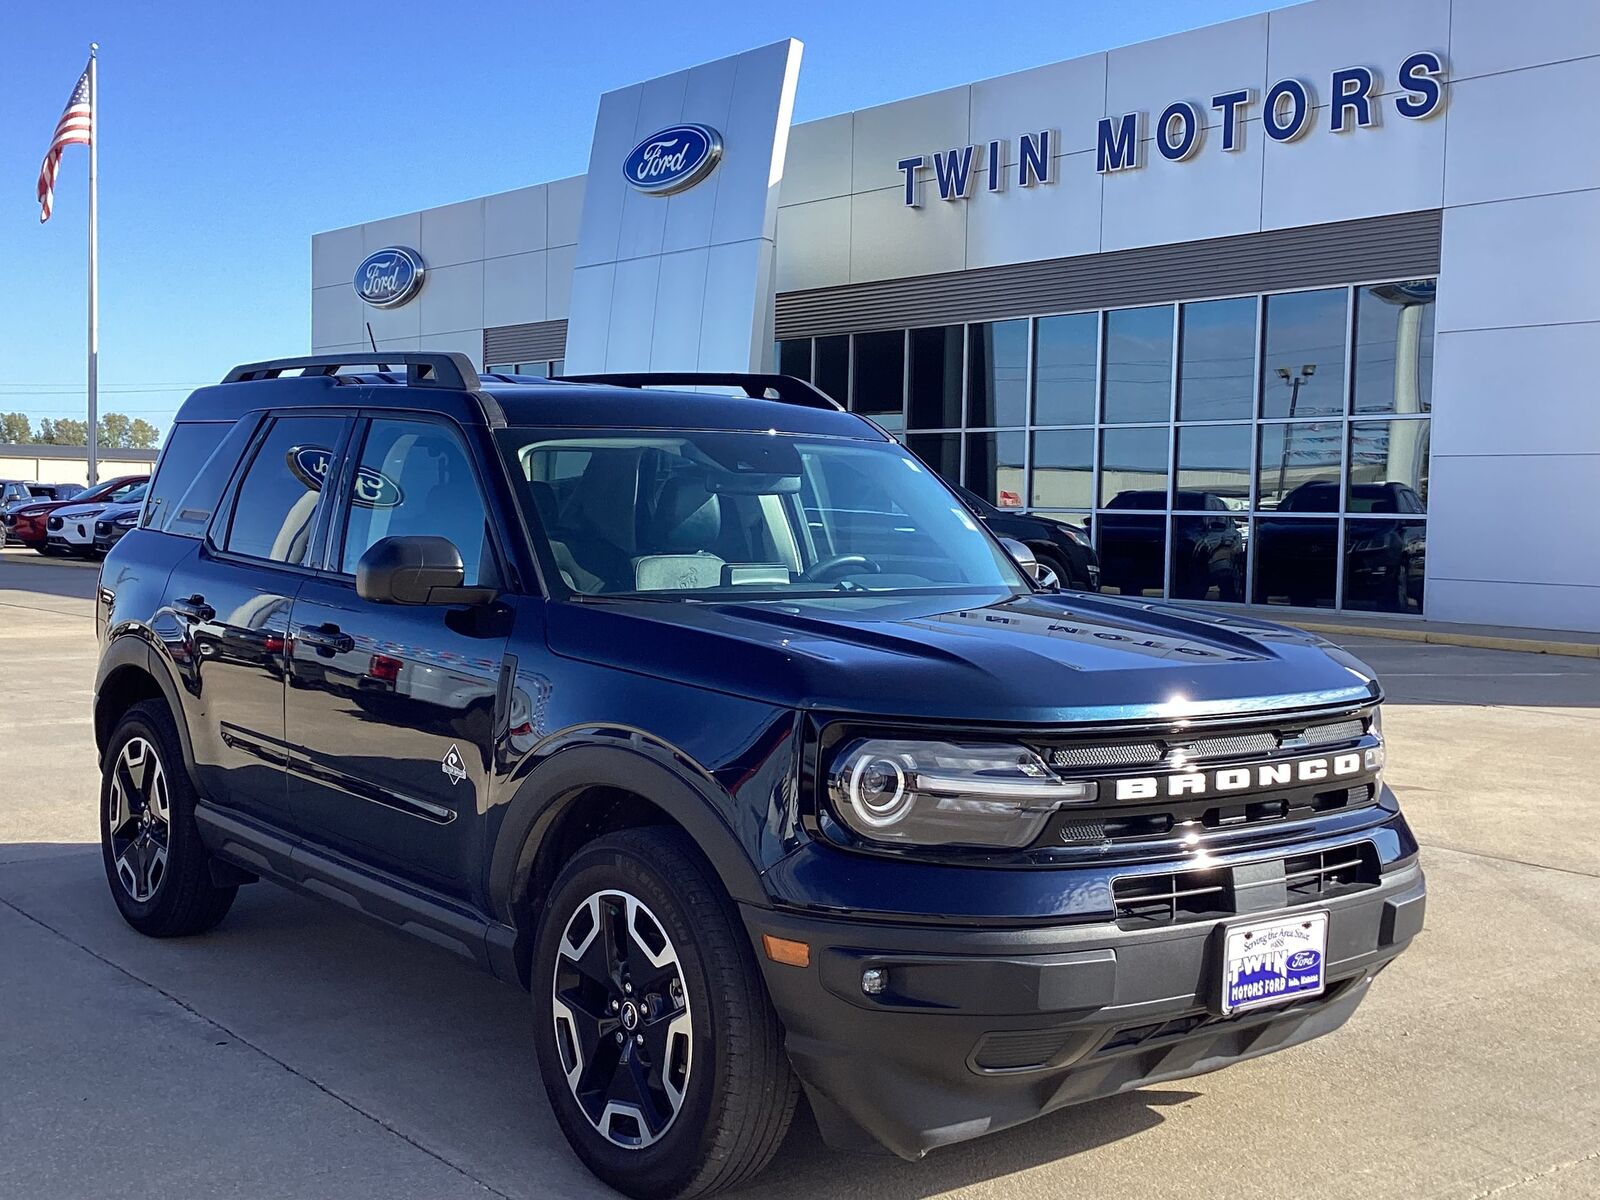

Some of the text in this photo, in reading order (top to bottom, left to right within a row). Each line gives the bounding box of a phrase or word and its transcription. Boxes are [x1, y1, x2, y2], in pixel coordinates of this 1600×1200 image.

[897, 49, 1446, 208] TWIN MOTORS
[637, 138, 690, 180] Ford
[363, 261, 399, 296] Ford
[1115, 753, 1361, 800] BRONCO
[1268, 930, 1279, 940] the
[1228, 949, 1289, 986] TWIN
[1291, 952, 1315, 968] Ford
[1231, 981, 1264, 1002] MOTORS
[1264, 977, 1286, 994] FORD
